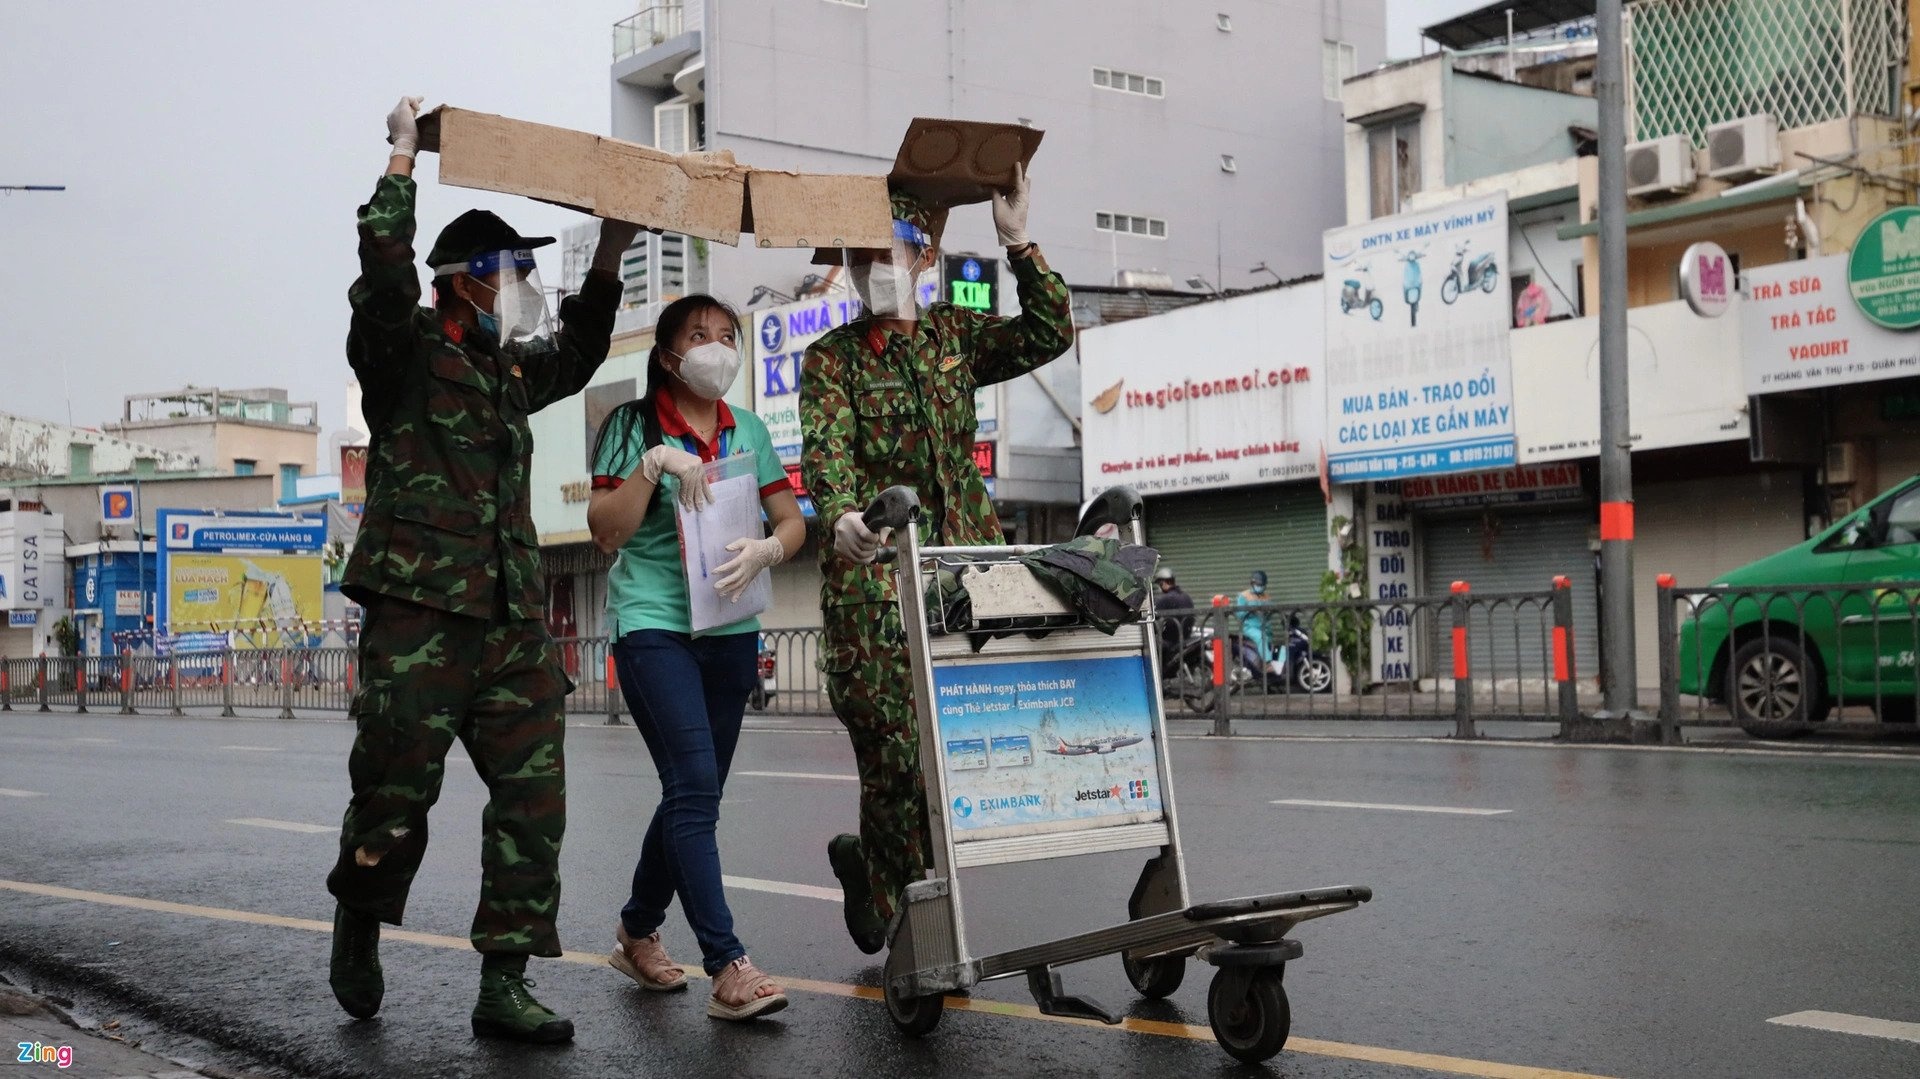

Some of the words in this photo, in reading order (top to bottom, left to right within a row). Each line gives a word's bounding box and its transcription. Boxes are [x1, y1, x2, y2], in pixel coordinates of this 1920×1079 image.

[1362, 233, 1392, 249] DNTN
[1396, 229, 1410, 242] XE
[1415, 221, 1440, 237] MÁY
[1477, 204, 1495, 222] MỸ
[1698, 255, 1726, 296] M
[952, 280, 991, 309] KIM
[1753, 281, 1782, 301] TRÀ
[1789, 275, 1822, 295] SỮA
[789, 300, 832, 337] NHÀ
[1770, 310, 1801, 331] TRÀ
[1789, 339, 1850, 362] YAOURT
[1774, 371, 1802, 382] HOÀNG
[1871, 359, 1896, 371] QUẬN
[1126, 367, 1310, 409] thegioisonmoi.com
[1343, 395, 1374, 415] MUA
[1378, 387, 1409, 411] BÁN
[1422, 382, 1464, 405] TRAO
[1468, 367, 1496, 397] ĐỔI
[1339, 419, 1368, 444] CÁC
[1373, 419, 1406, 444] LOẠI
[1412, 416, 1431, 436] XE
[1436, 405, 1469, 433] GẮN
[1474, 402, 1510, 427] MÁY
[1145, 457, 1155, 468] và
[1215, 448, 1240, 461] hàng
[1242, 445, 1271, 457] chính
[1482, 472, 1500, 491] XE
[278, 530, 302, 543] HÀNG
[303, 534, 313, 543] 08
[1374, 530, 1410, 548] TRAO
[23, 534, 38, 602] CATSA
[1380, 552, 1405, 574] ĐỔI
[1379, 580, 1408, 599] CÁC
[10, 613, 36, 623] CATSA
[1387, 636, 1404, 653] XE
[940, 683, 964, 697] PHÁT
[965, 682, 992, 695] HÀNH
[993, 684, 1016, 695] ngay,
[1017, 681, 1037, 692] thỏa
[1038, 679, 1059, 691] thích
[1060, 678, 1076, 689] BAY
[942, 704, 964, 716] cùng
[965, 702, 980, 714] Thẻ
[981, 701, 1011, 713] Jetstar
[1018, 698, 1059, 710] Eximbank
[1060, 697, 1075, 708] JCB
[1075, 789, 1111, 802] Jetstar
[1129, 780, 1149, 800] JCB
[979, 794, 1042, 811] EXIMBANK
